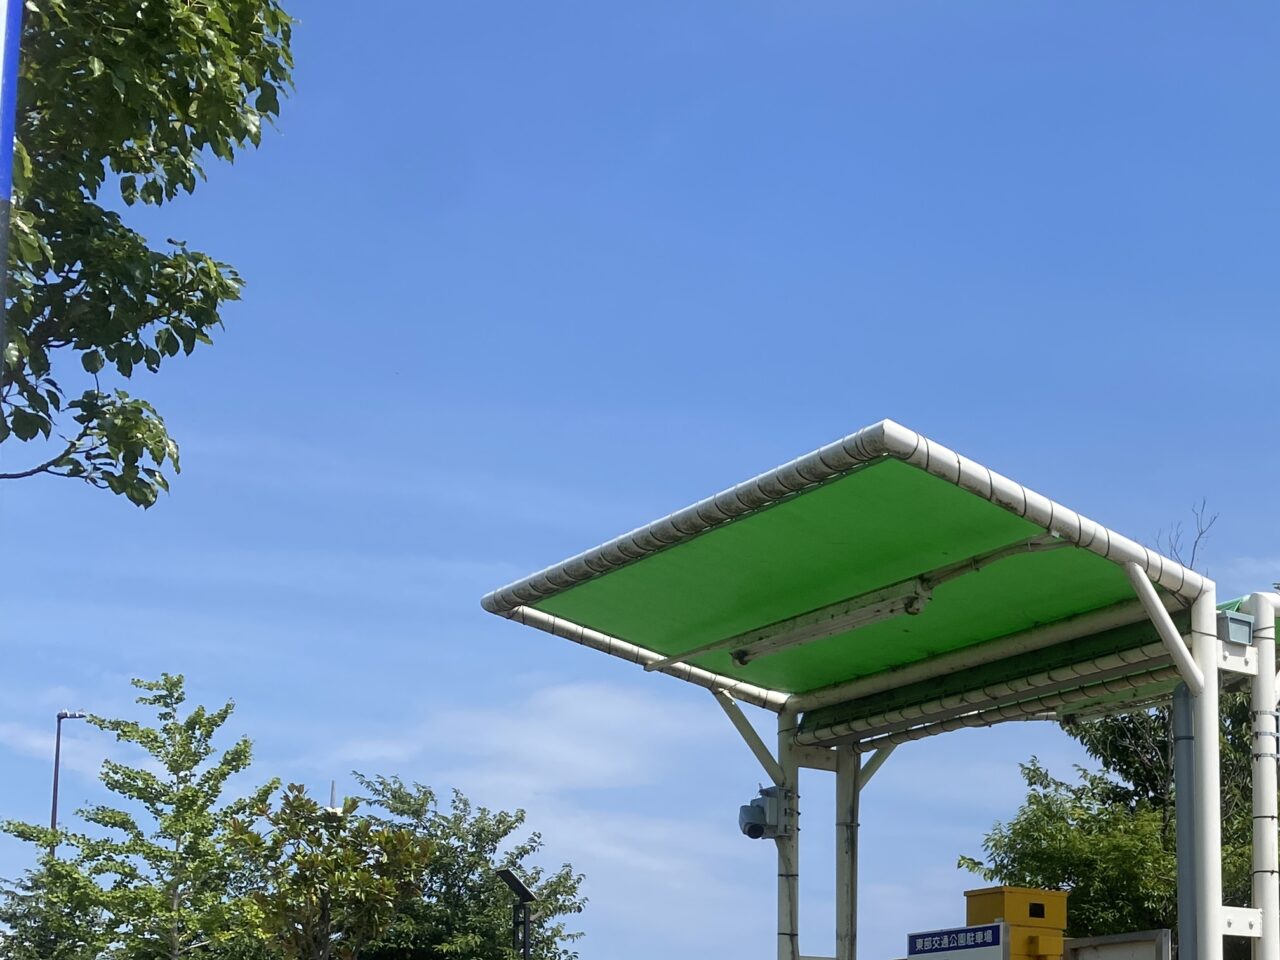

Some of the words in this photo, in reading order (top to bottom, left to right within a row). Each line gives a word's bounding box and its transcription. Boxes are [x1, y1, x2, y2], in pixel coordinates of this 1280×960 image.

[916, 930, 993, 951] 東部交通公園駐車場
